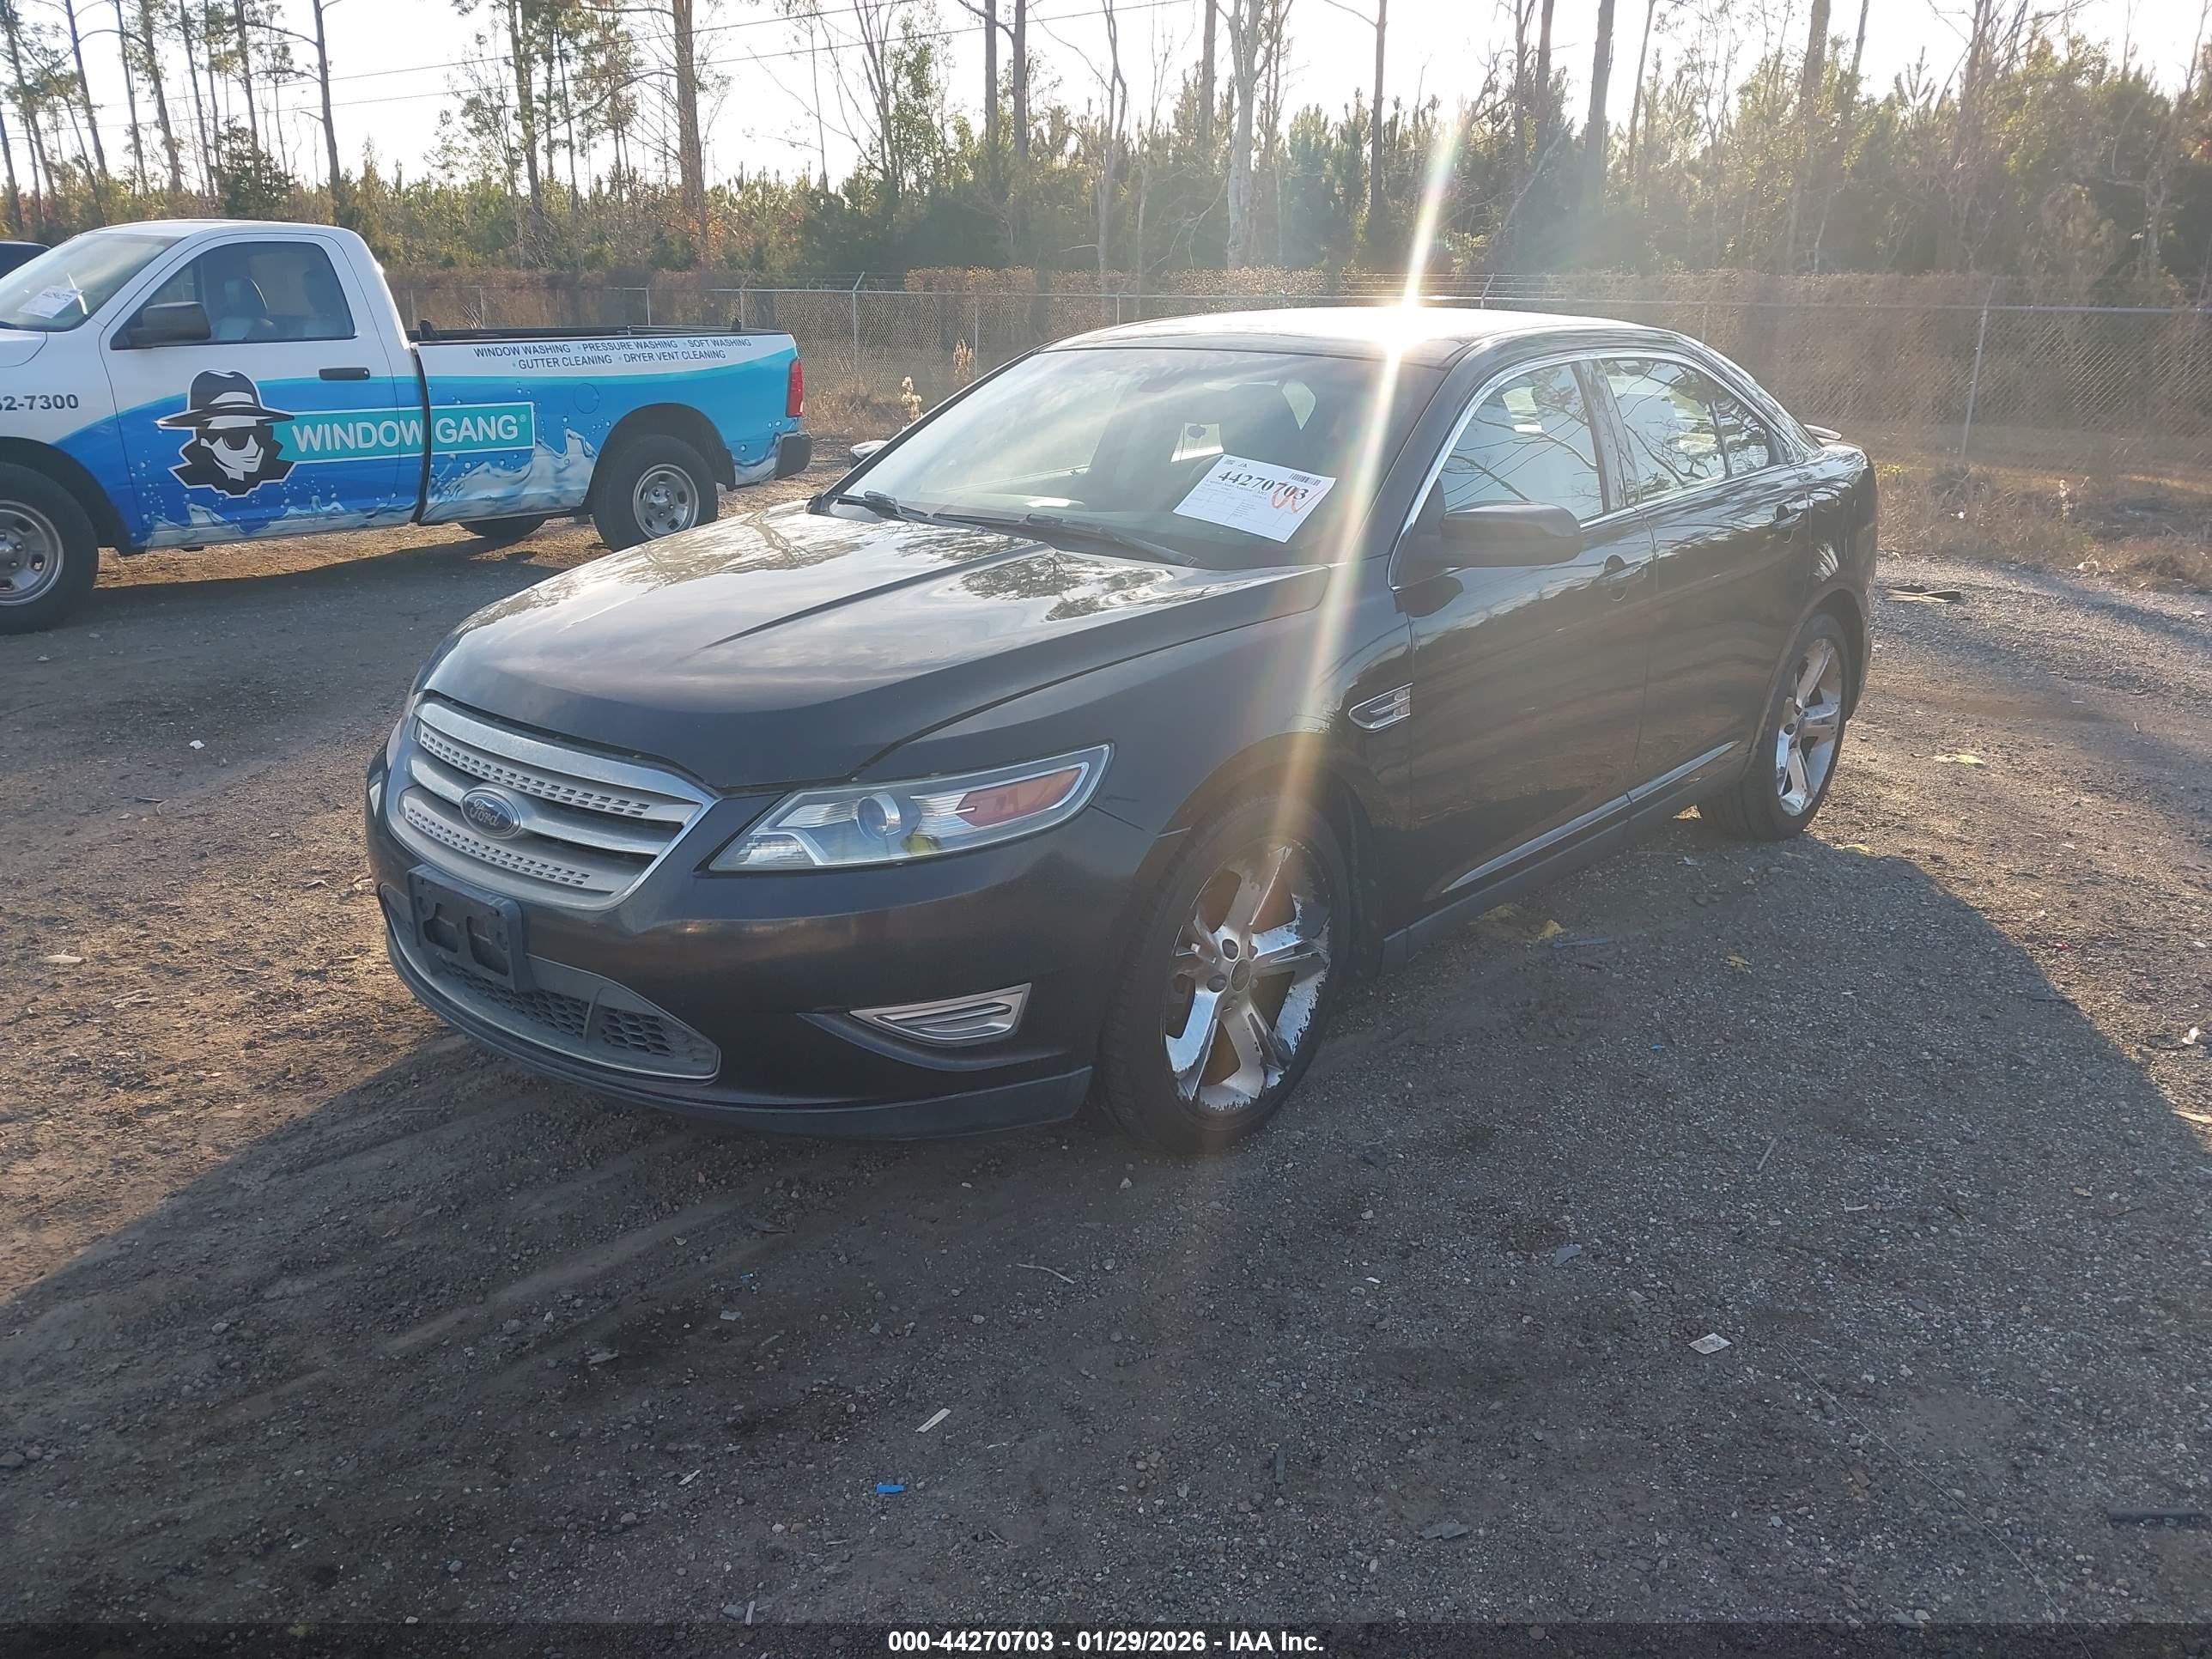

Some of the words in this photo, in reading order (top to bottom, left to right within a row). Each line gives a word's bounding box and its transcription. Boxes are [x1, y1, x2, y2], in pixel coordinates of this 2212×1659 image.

[474, 345, 520, 357] WINDOW
[521, 343, 571, 355] WASHING
[582, 342, 633, 352] PRESSURE
[633, 340, 678, 350] WASHING
[687, 339, 709, 348] SOFT
[709, 338, 751, 347] WASHING
[518, 357, 560, 369] GUTTER
[562, 355, 612, 367] CLEANING
[623, 352, 654, 363] DRYER
[655, 350, 680, 362] VENT
[681, 349, 726, 360] CLEANING
[0, 394, 79, 411] 2-7300
[292, 419, 423, 453] WINDOW
[1218, 471, 1310, 500] 44270703
[470, 799, 501, 826] Ford
